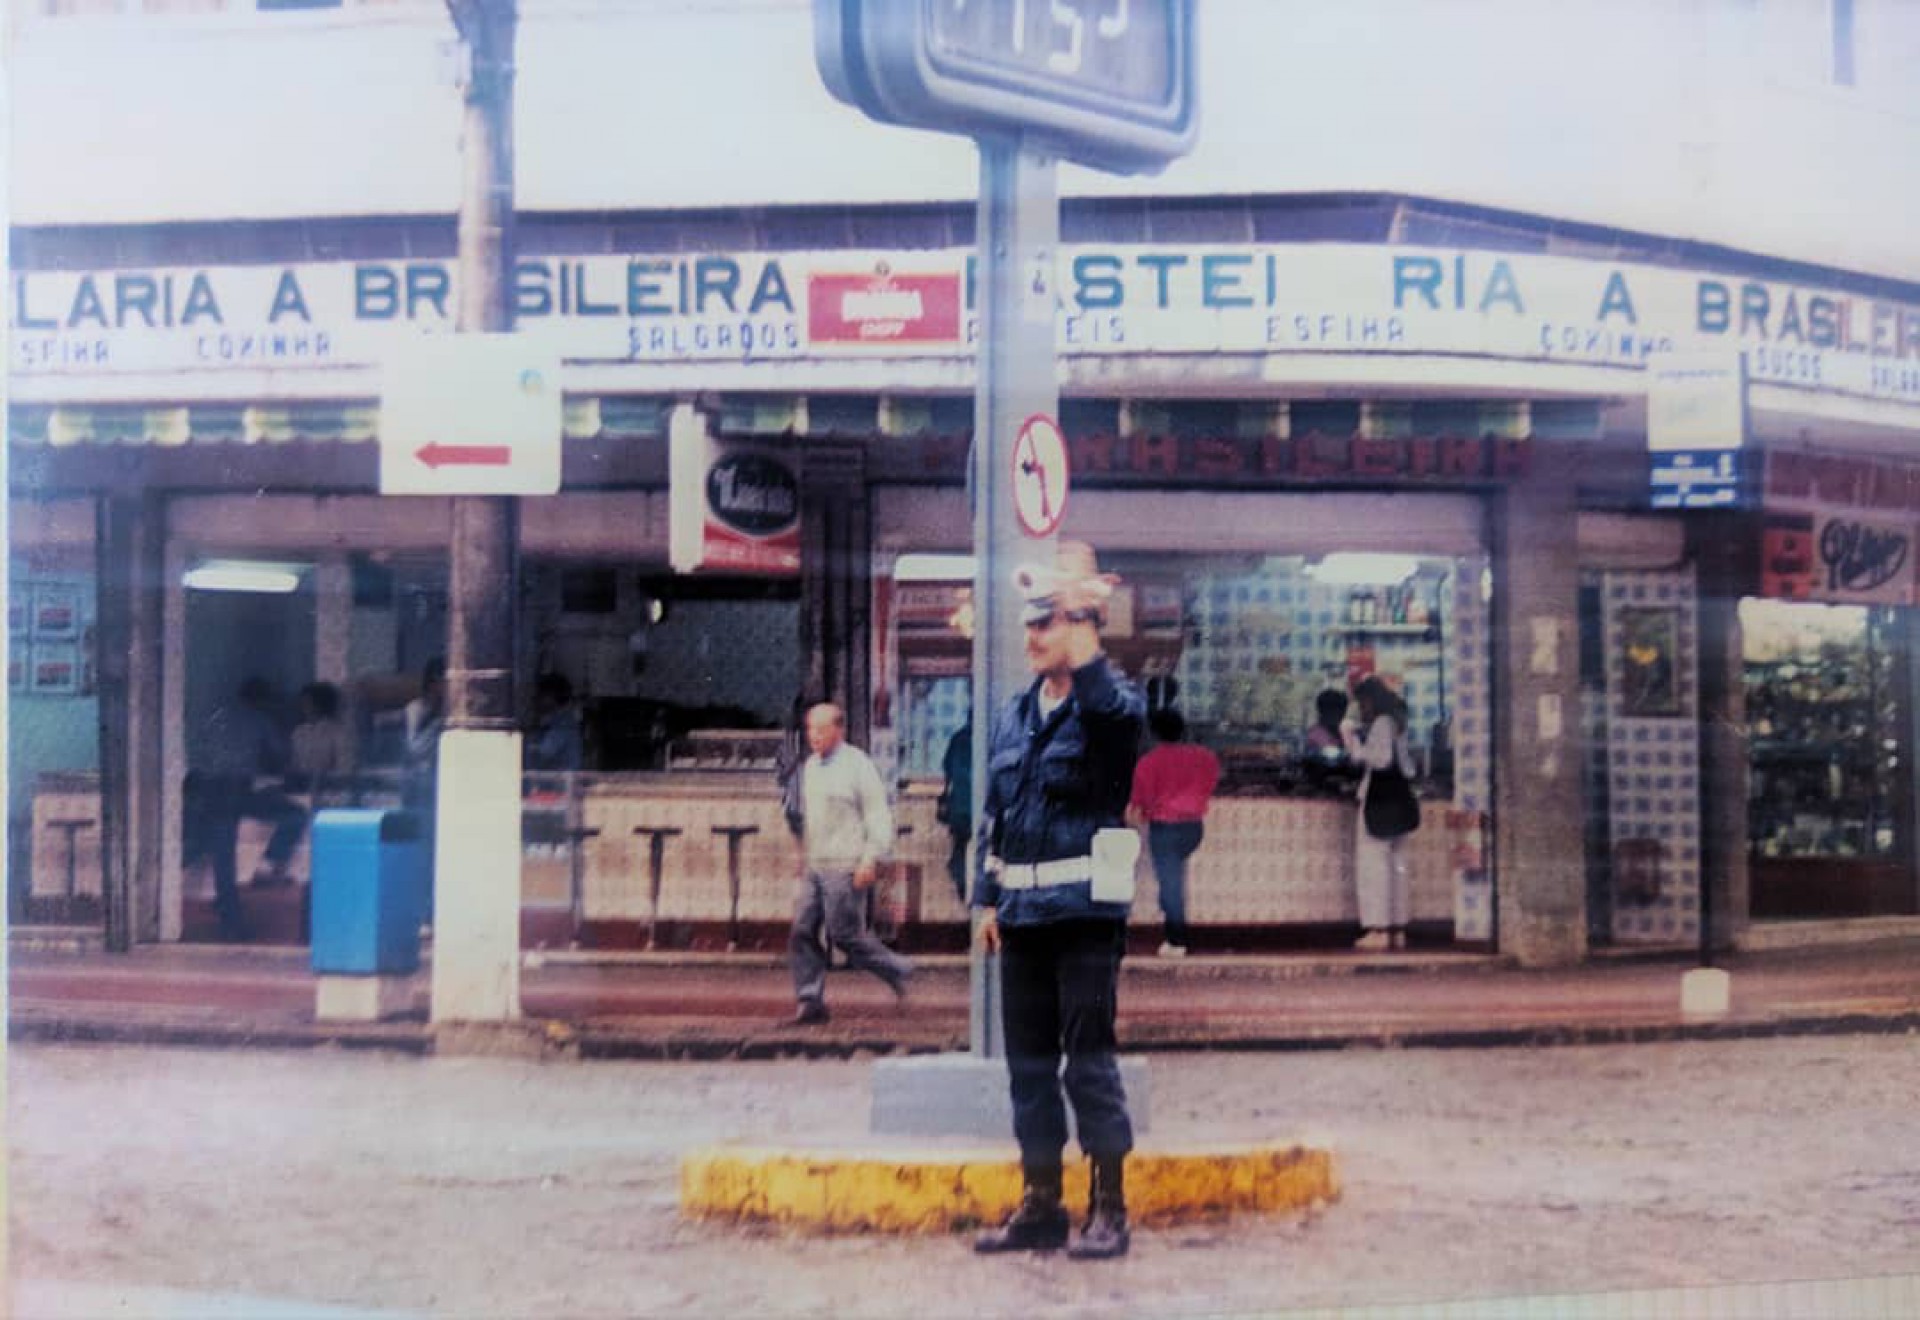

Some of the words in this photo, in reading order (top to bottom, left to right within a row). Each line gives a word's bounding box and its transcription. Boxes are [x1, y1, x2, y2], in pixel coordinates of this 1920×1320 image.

[15, 272, 223, 329] LARIA
[268, 269, 311, 323] A
[354, 257, 798, 320] BRSILEIRA
[1392, 254, 1526, 314] RIA
[1597, 270, 1637, 326] A
[198, 330, 331, 360] COXINHA
[628, 323, 799, 358] SALGADOS
[1266, 313, 1405, 344] ESFIHA
